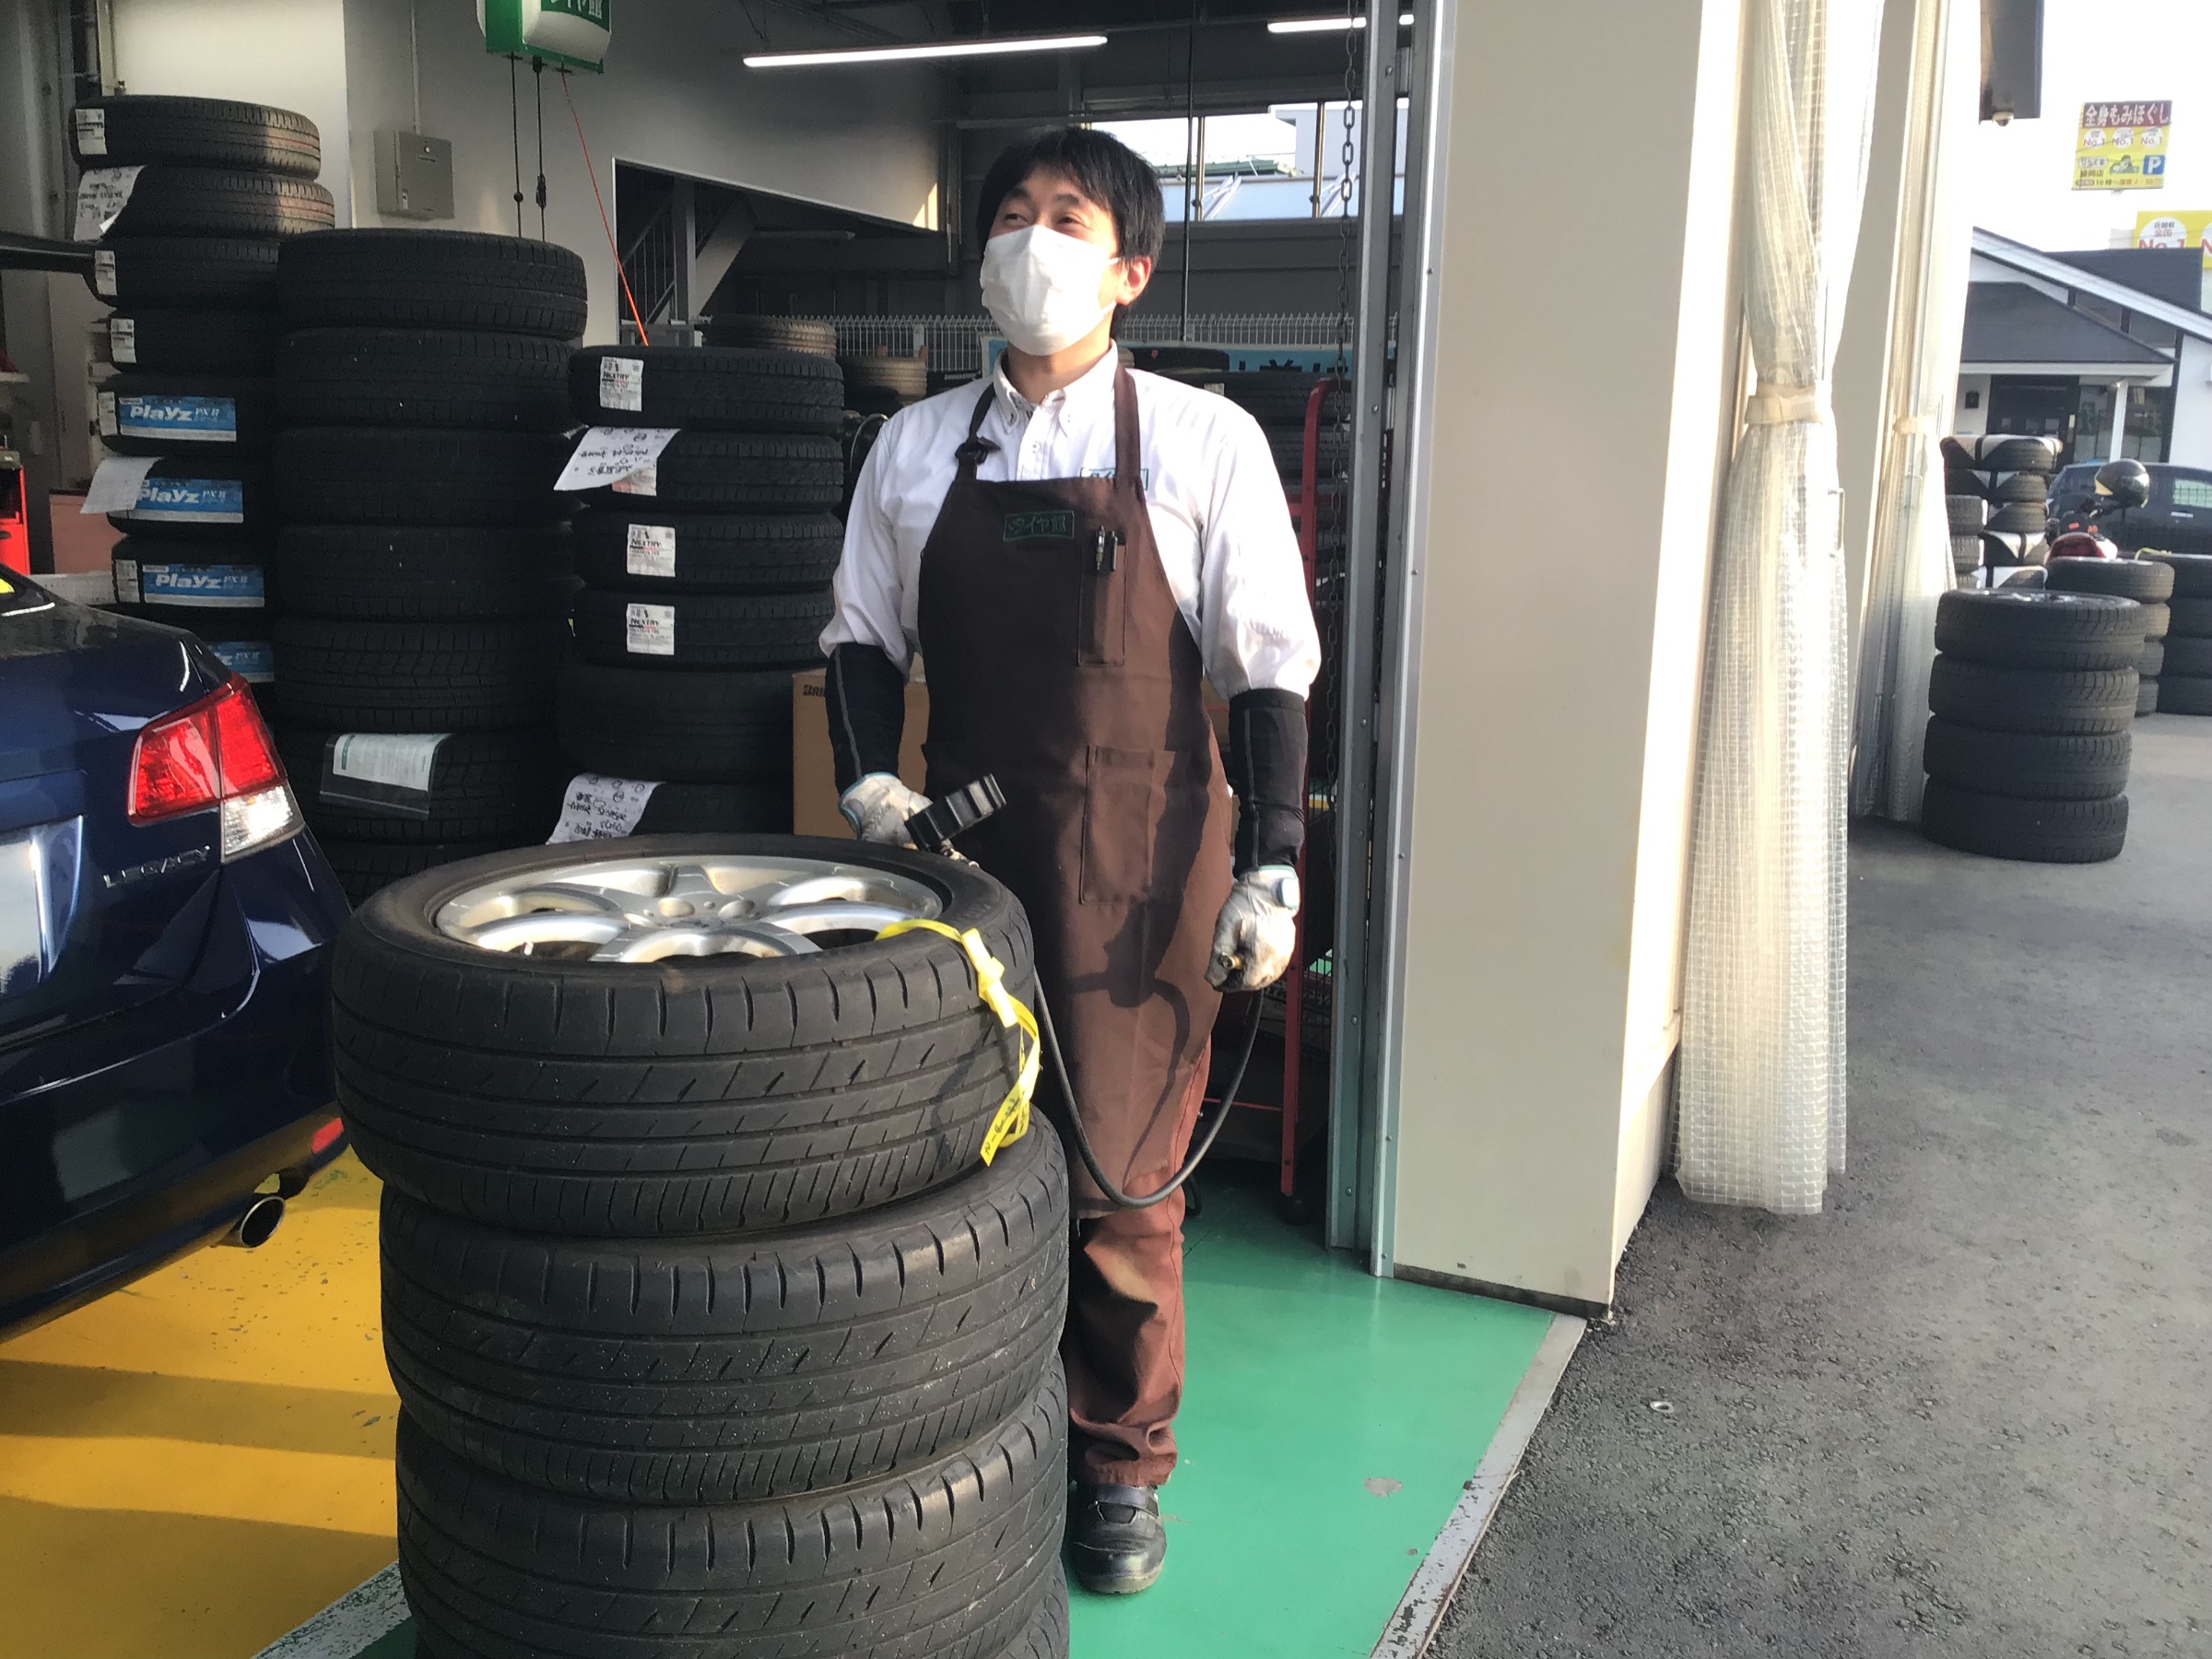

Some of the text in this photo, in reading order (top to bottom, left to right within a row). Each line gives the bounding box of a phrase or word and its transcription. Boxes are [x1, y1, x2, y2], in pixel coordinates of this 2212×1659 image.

[2085, 103, 2169, 127] 全身もみほぐし
